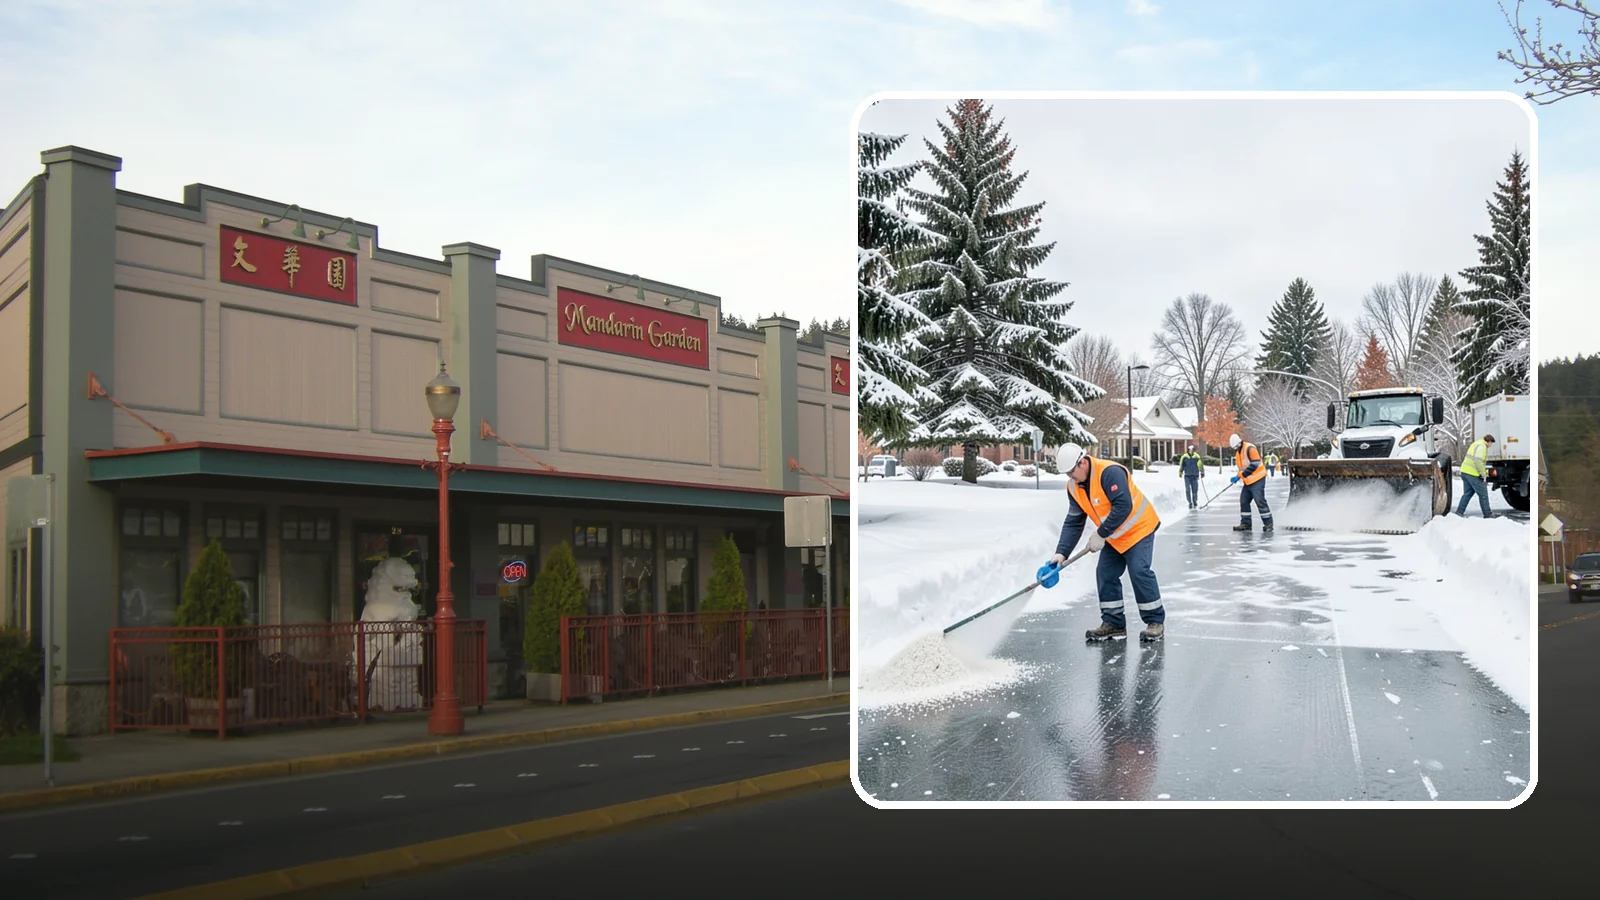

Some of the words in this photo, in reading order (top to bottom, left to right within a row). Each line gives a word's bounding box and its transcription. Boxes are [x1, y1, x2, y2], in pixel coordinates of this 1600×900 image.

[231, 236, 346, 290] 文華園
[564, 302, 643, 341] Mandarin
[648, 320, 701, 352] Garden
[834, 363, 846, 386] 文
[503, 565, 527, 578] OPEN
